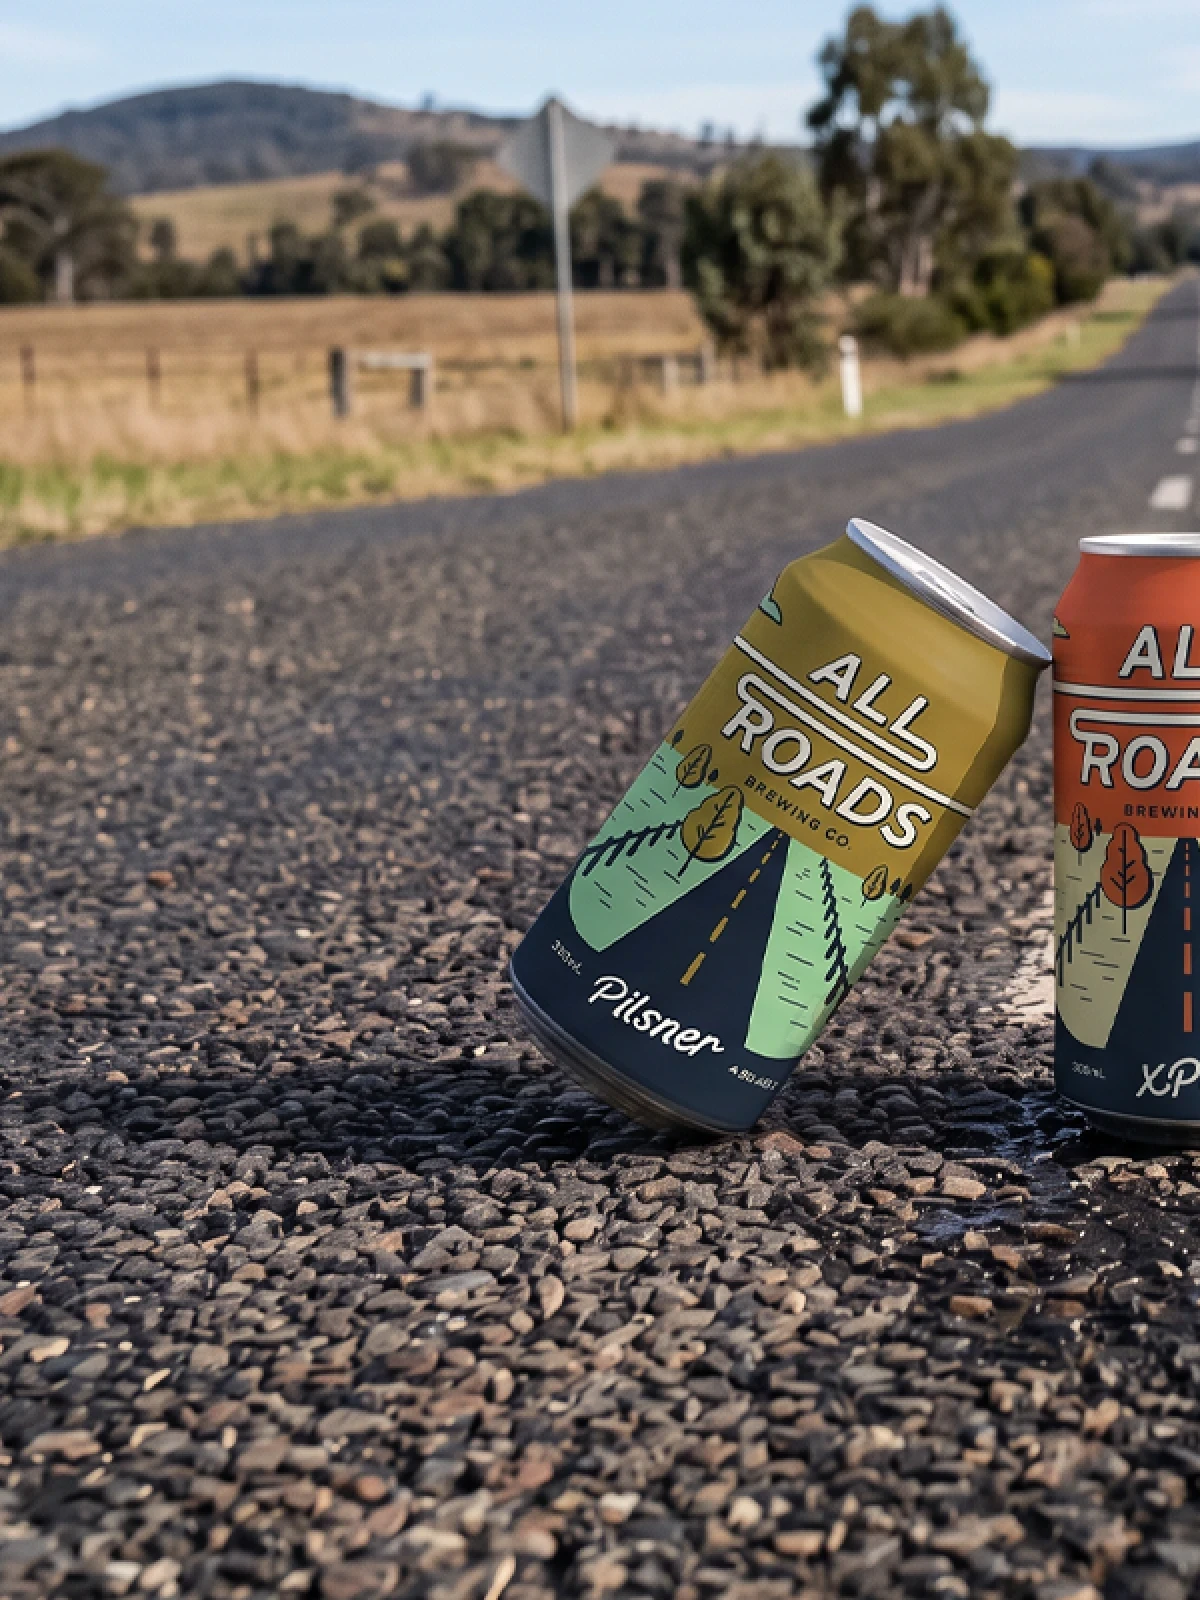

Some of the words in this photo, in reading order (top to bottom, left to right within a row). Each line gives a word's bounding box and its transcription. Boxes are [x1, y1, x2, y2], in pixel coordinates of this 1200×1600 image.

[720, 672, 932, 849] ROADS
[806, 652, 938, 773] ALL
[743, 774, 821, 830] BREWING
[825, 827, 851, 850] CO.
[588, 975, 725, 1057] Pilsner
